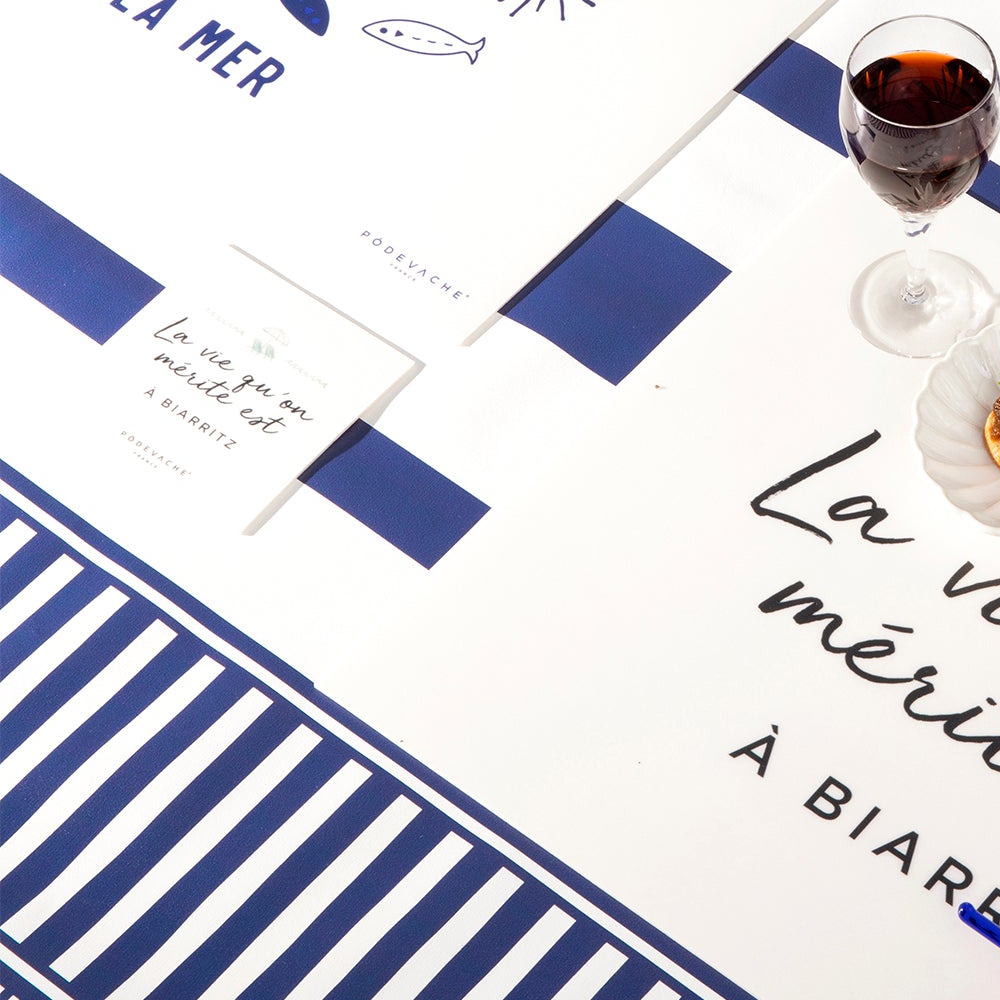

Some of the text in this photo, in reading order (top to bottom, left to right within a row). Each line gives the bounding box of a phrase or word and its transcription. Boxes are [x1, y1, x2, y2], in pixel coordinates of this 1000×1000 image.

[178, 20, 286, 98] MER
[154, 316, 194, 345] La
[200, 347, 235, 371] vie
[154, 352, 287, 435] mérite est
[161, 398, 238, 450] BIARRITZ
[750, 428, 915, 544] La
[728, 724, 780, 778] À
